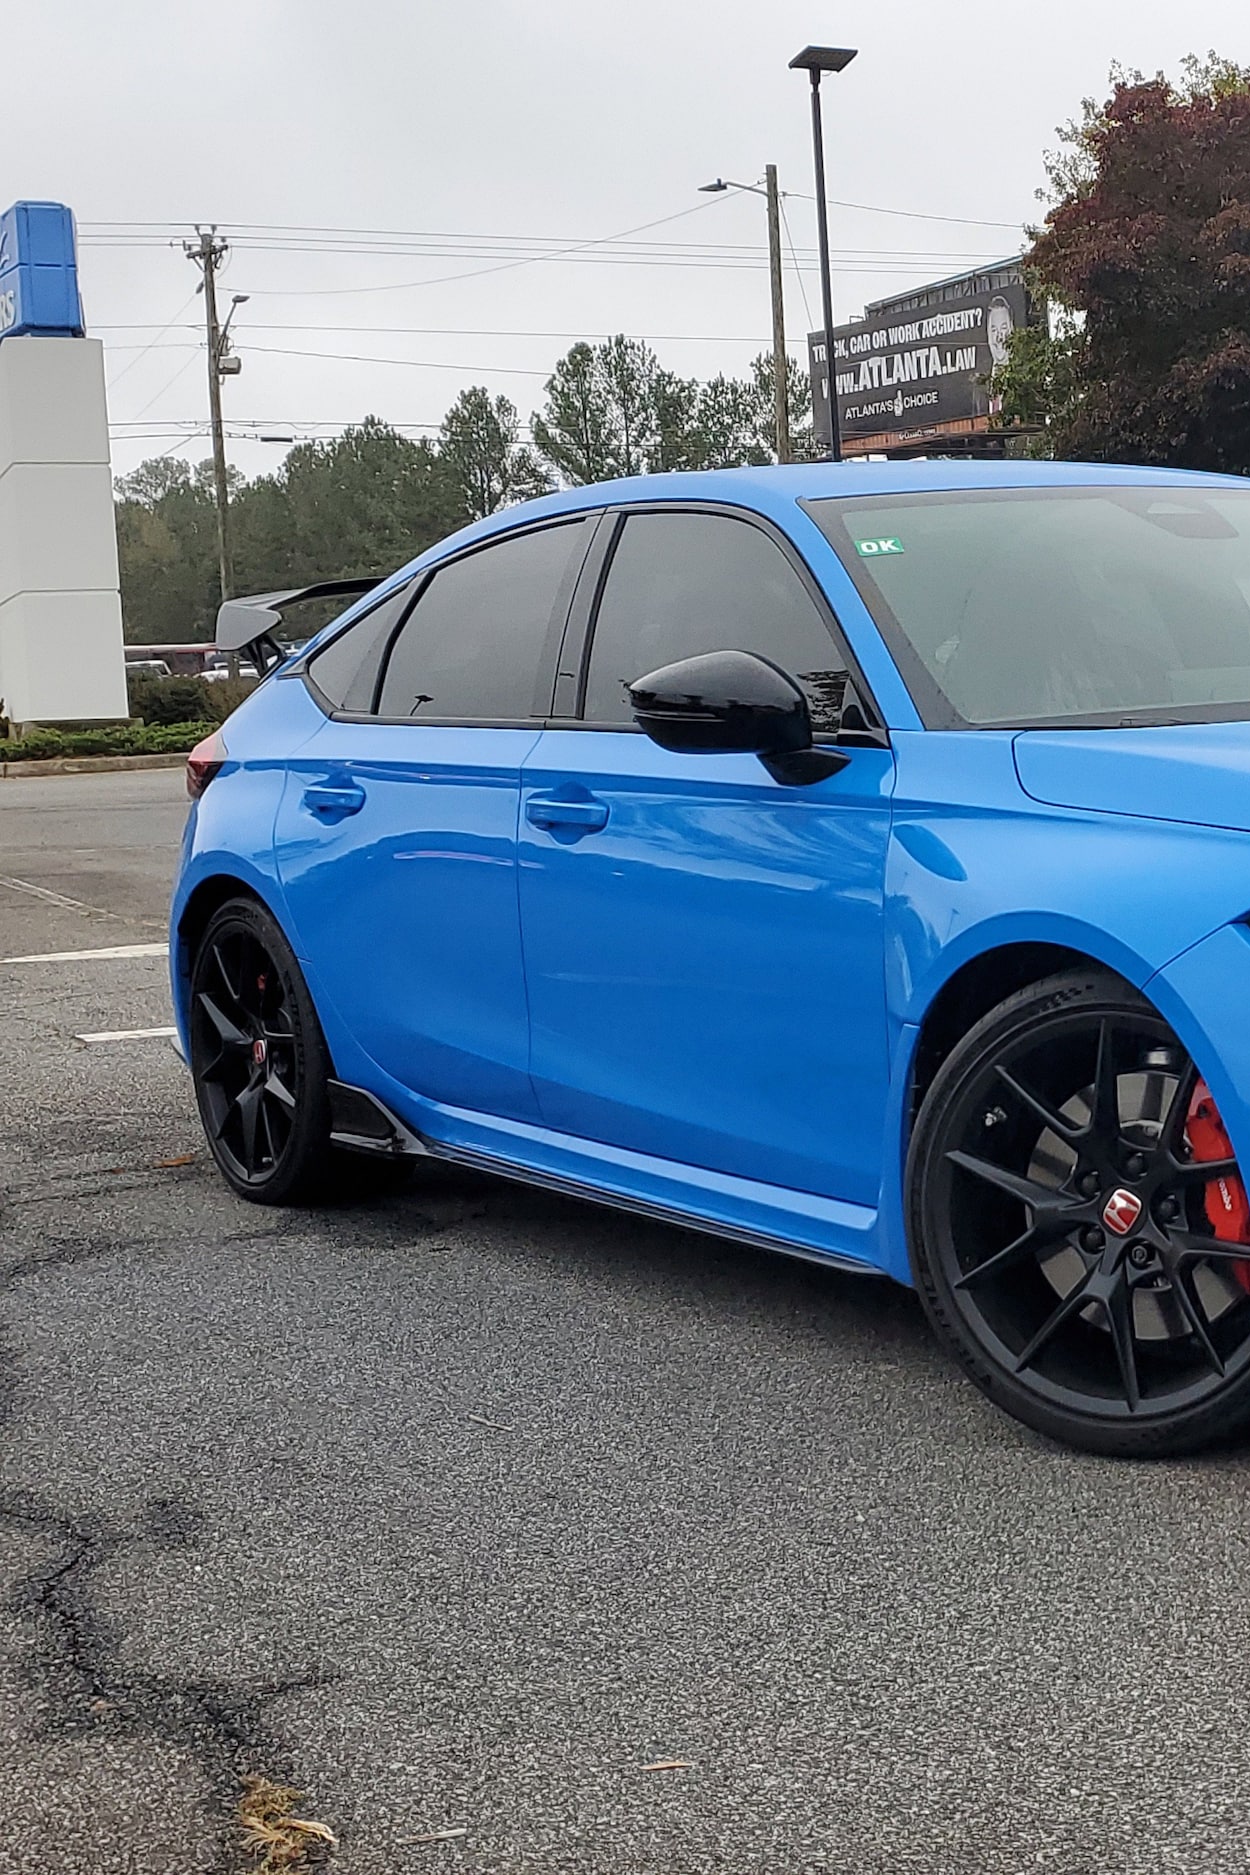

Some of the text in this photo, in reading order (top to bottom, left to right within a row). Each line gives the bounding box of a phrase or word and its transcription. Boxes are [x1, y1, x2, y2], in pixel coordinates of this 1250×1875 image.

[812, 307, 983, 363] TRCK, CAR OR WORK ACCIDENT?
[845, 391, 939, 420] ATLANTA'S CHOICE
[860, 540, 900, 553] OK
